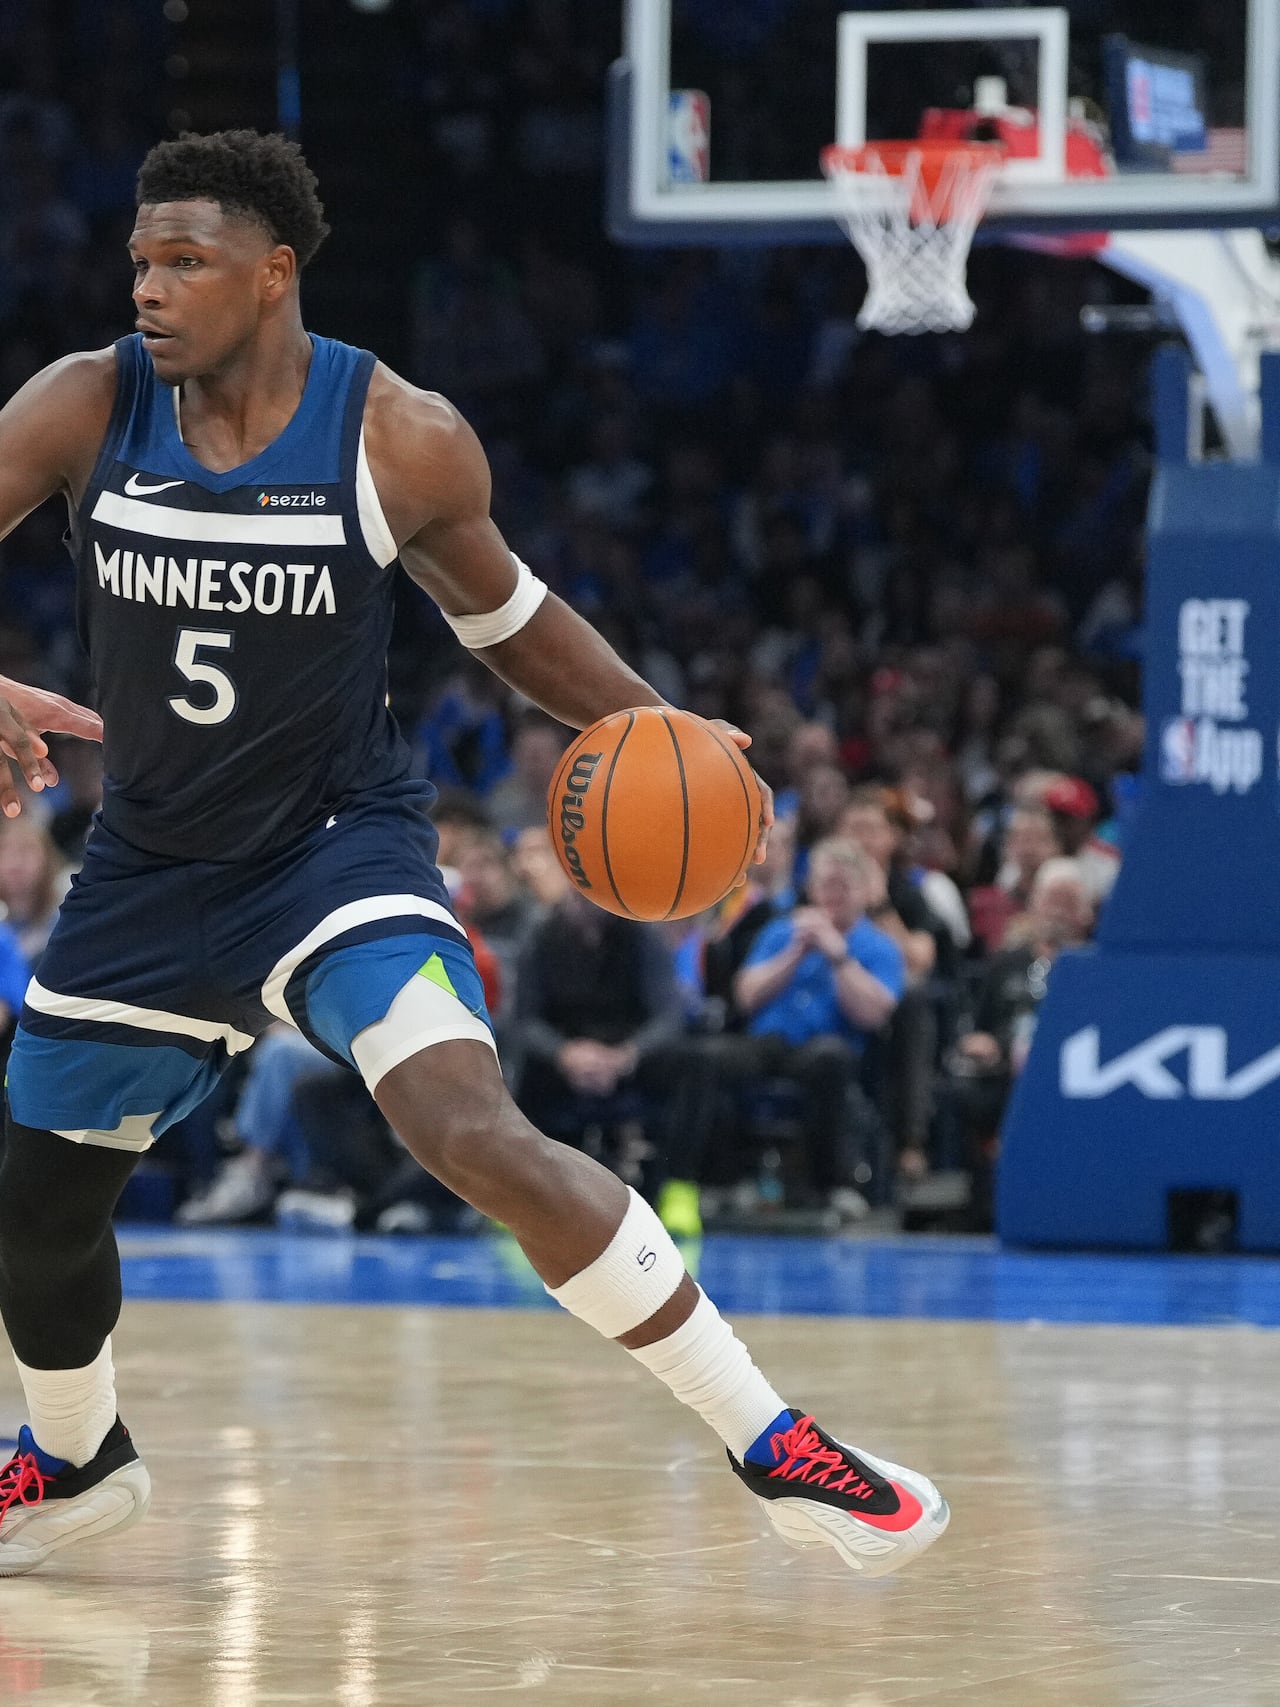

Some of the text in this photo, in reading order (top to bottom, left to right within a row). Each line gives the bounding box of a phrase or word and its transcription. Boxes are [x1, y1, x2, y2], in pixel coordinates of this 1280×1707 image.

[270, 491, 327, 507] sezzle
[94, 541, 337, 616] MINNESOTA
[169, 625, 239, 726] 5
[560, 751, 604, 890] Wilson
[636, 1245, 657, 1272] 5
